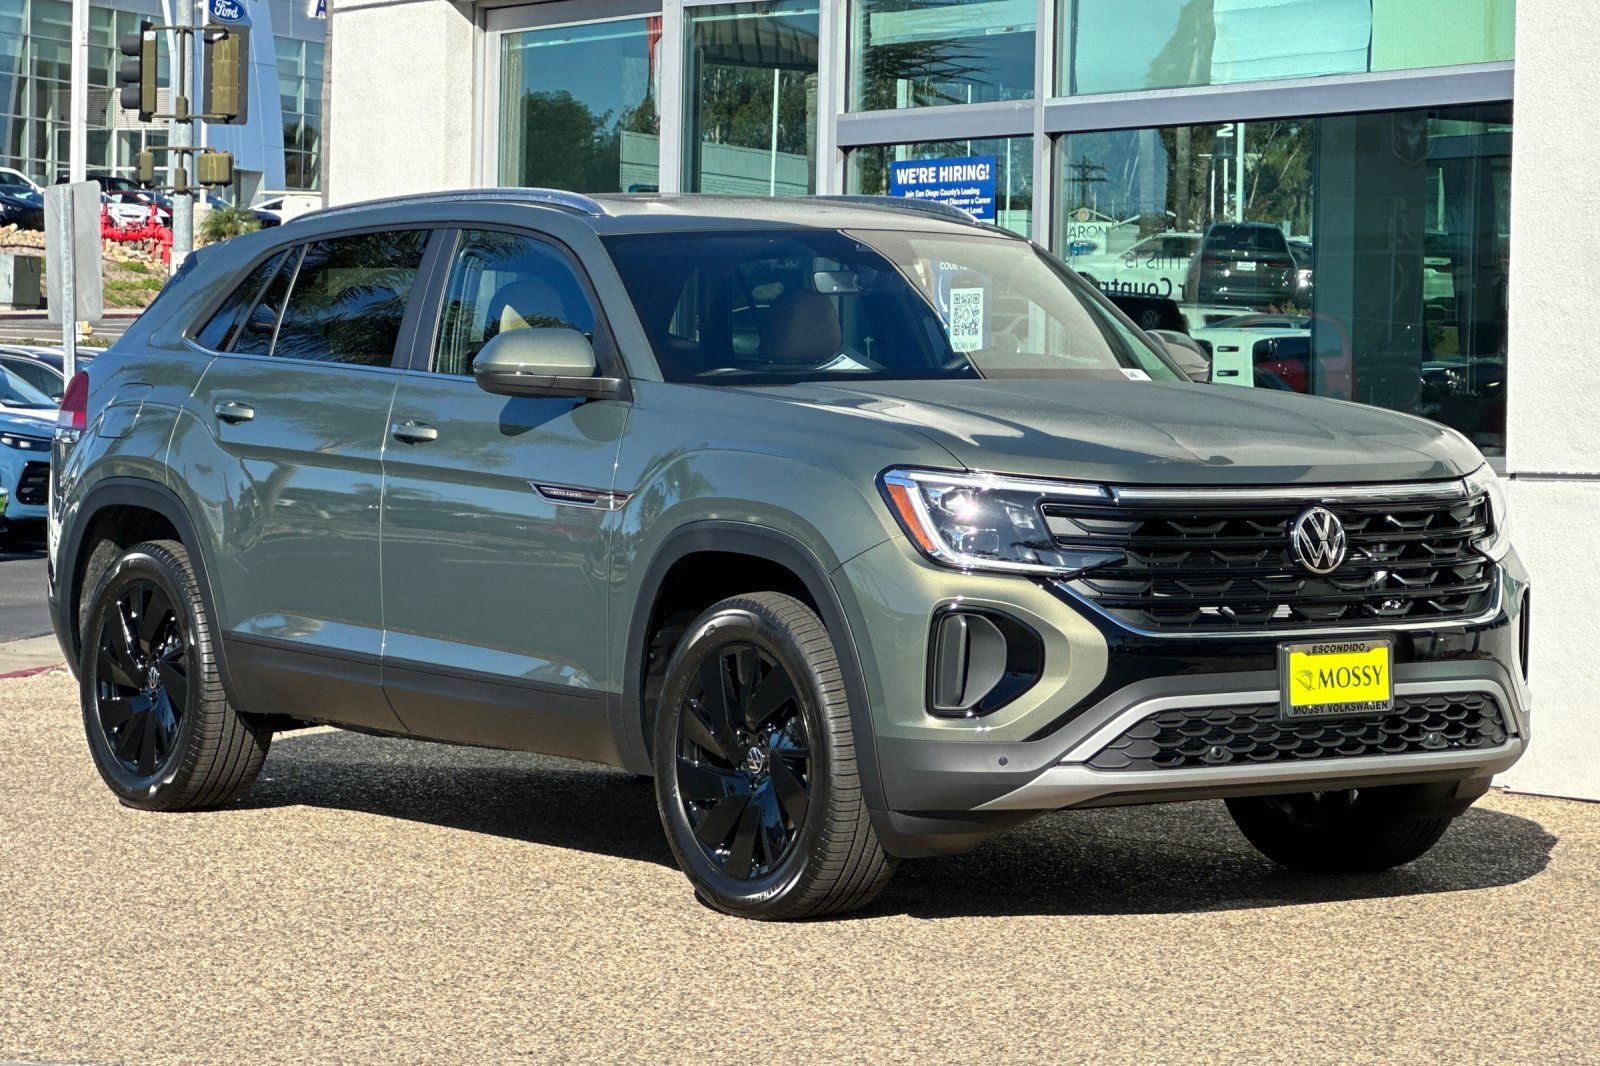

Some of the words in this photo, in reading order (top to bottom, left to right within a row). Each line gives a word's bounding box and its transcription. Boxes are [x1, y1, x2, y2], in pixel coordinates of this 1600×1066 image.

[214, 0, 239, 18] Ford
[896, 166, 937, 185] WE'RE
[939, 163, 990, 182] HIRING!
[905, 190, 915, 198] Join
[916, 189, 925, 197] San
[925, 189, 939, 198] Diego
[940, 188, 961, 198] County's
[961, 187, 980, 196] Leading
[949, 197, 970, 206] Discover
[975, 196, 992, 205] Career
[970, 205, 985, 214] Level.
[954, 342, 968, 351] SCAN
[1312, 643, 1365, 654] ESCONDIDO
[1318, 664, 1383, 690] MOSSY
[1293, 704, 1325, 716] MOSSY
[1327, 700, 1388, 713] VOLKSWAGEN
